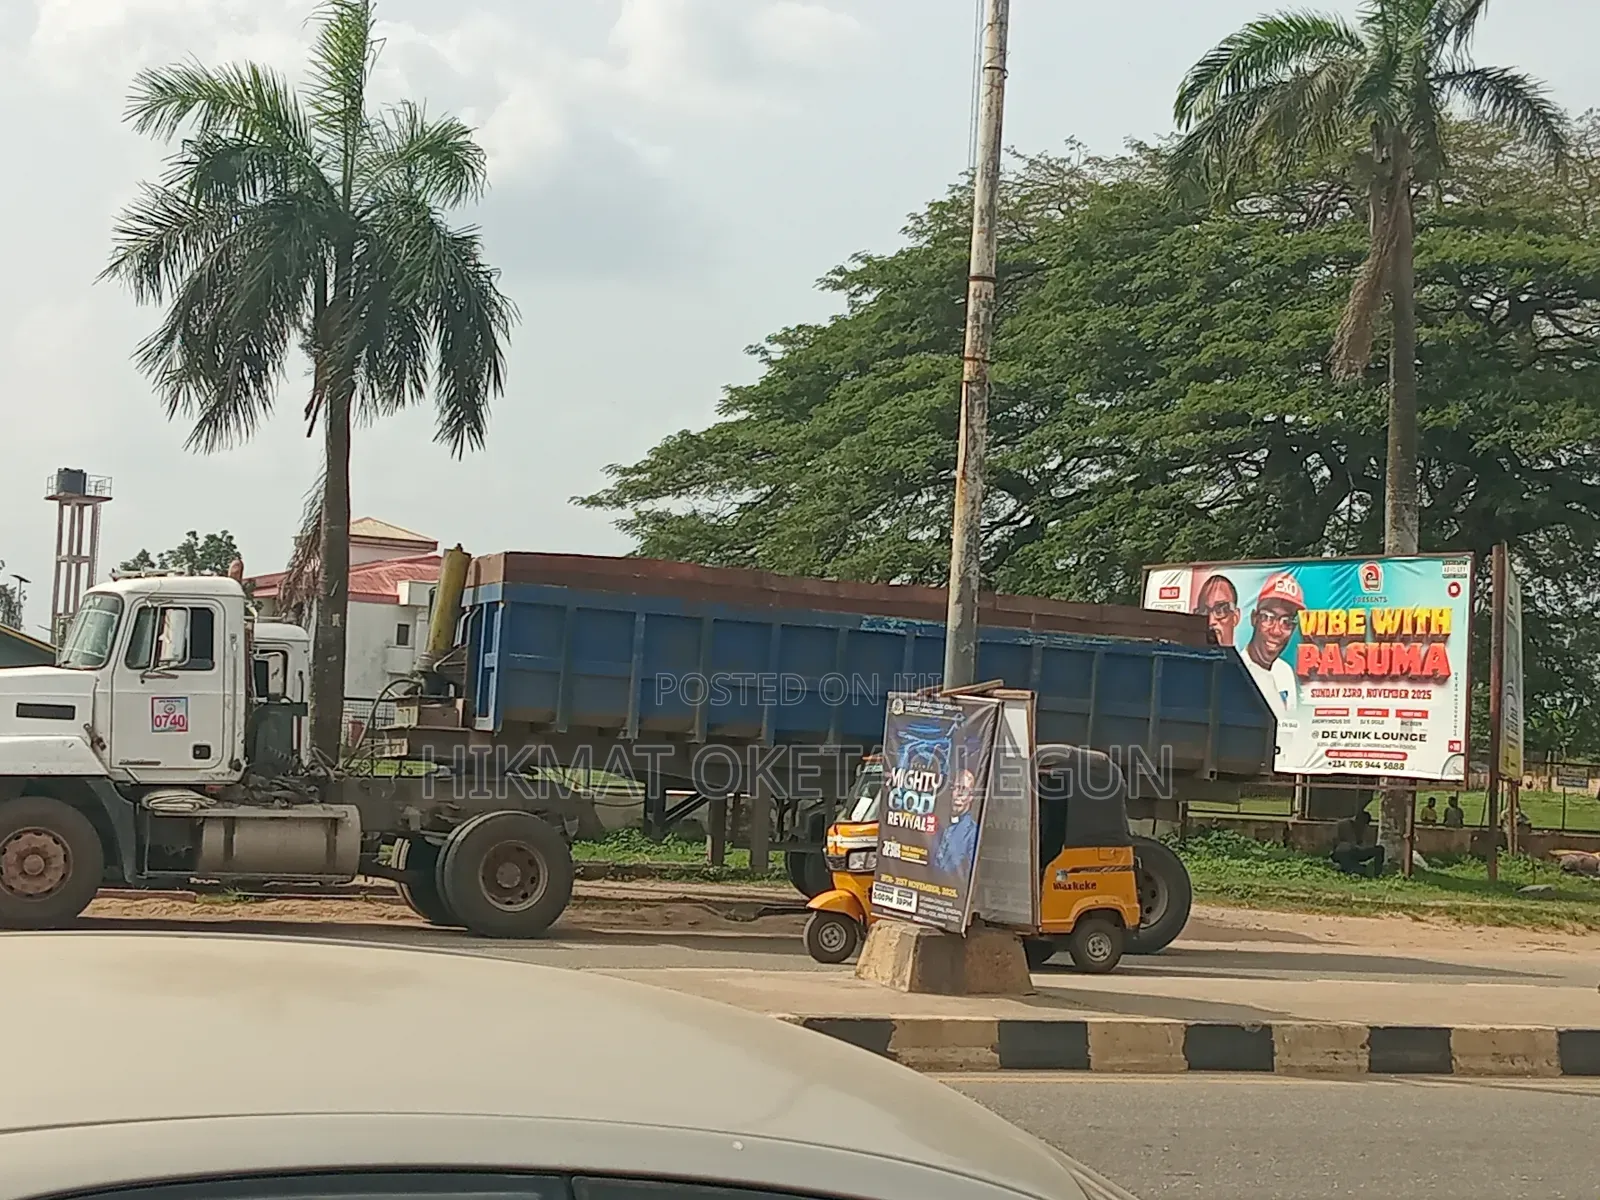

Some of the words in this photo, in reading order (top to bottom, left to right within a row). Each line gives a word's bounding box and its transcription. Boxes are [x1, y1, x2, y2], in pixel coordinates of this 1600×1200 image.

[1298, 608, 1366, 637] VIBE
[1371, 607, 1453, 637] WITH
[1296, 642, 1452, 677] PASUMA
[1310, 688, 1340, 698] SUNDAY
[1341, 688, 1364, 699] 23RD,
[1366, 689, 1408, 699] NOVEMBER
[1411, 690, 1431, 699] 2025
[154, 714, 186, 728] 0740
[1321, 730, 1338, 739] DE
[1340, 731, 1371, 740] UNIK
[1374, 732, 1427, 742] LOUNGE
[1328, 760, 1346, 768] +234
[886, 767, 943, 793] MIGHTY
[888, 788, 936, 815] GOD
[887, 811, 926, 831] REVIVAL
